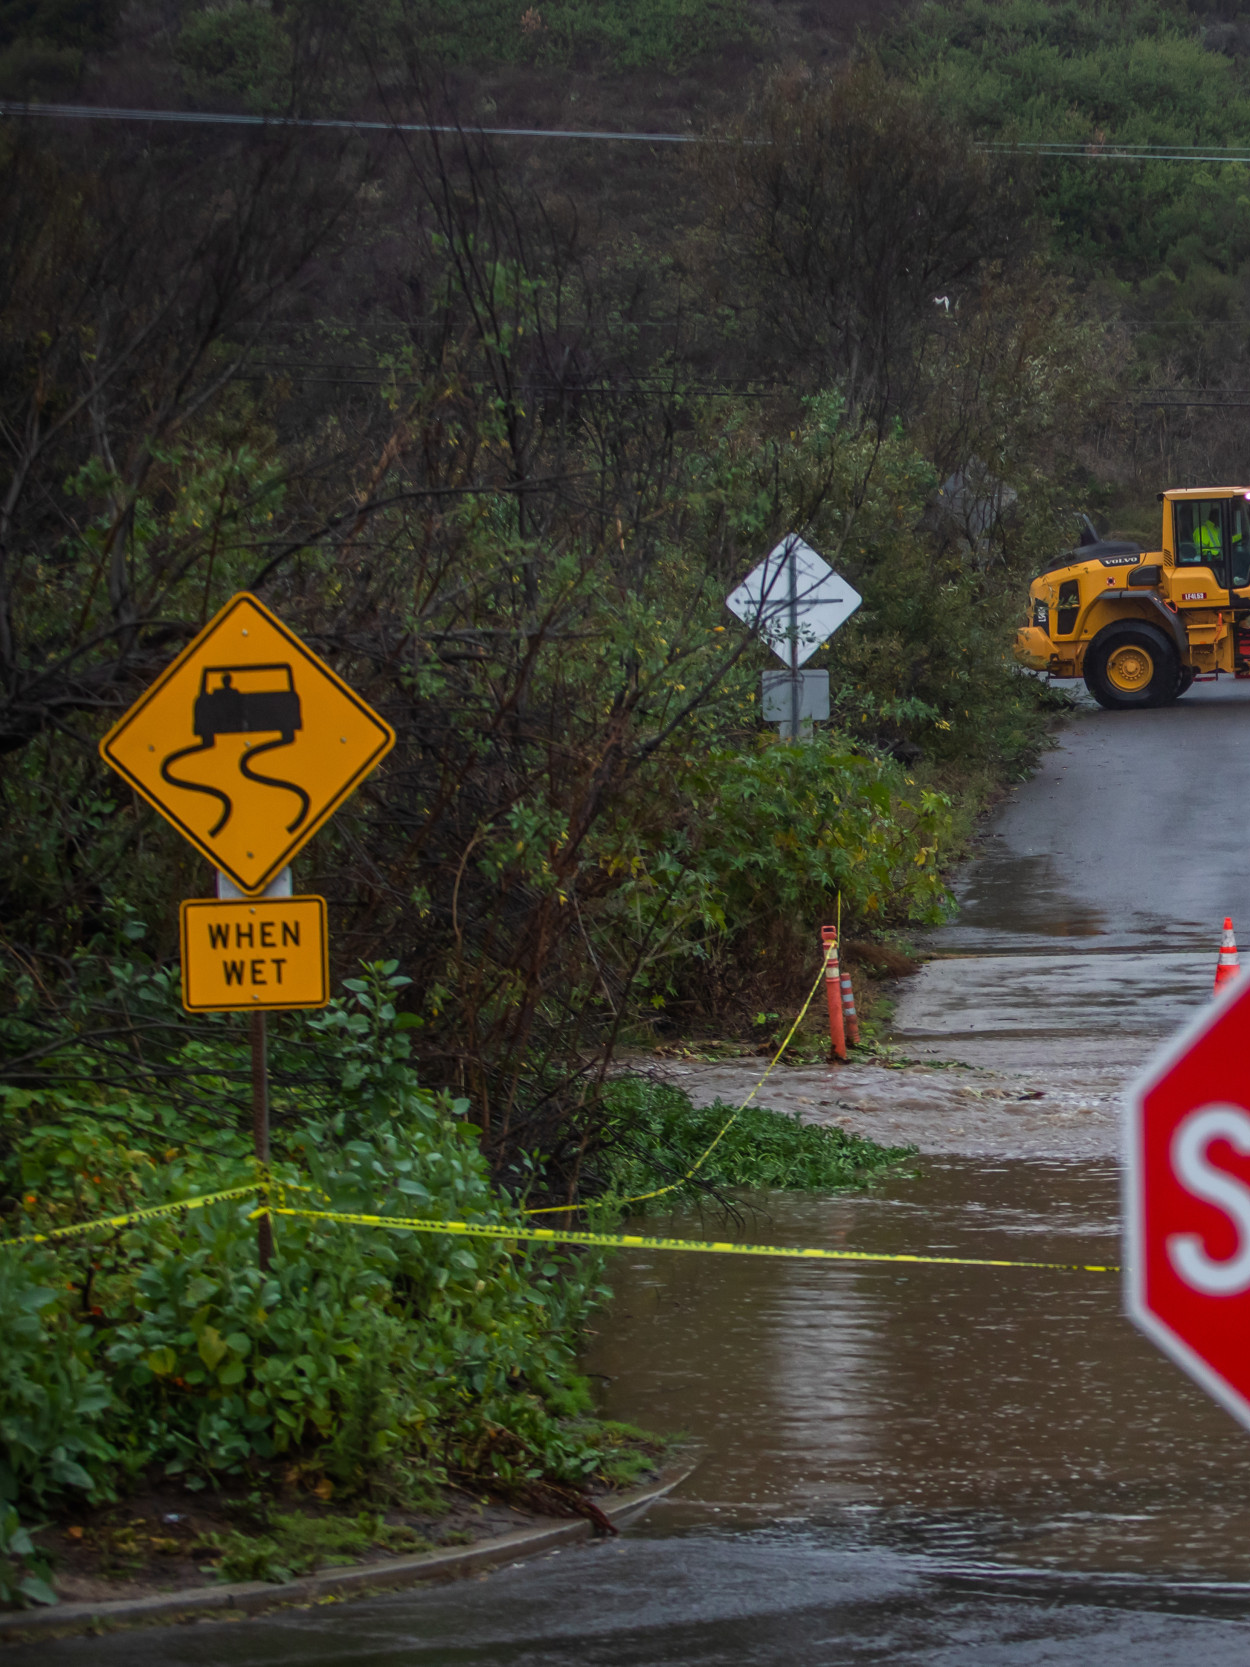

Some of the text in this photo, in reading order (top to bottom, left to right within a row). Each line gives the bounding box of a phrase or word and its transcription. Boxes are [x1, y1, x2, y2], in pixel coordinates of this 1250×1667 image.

[1104, 557, 1138, 565] VOLVO
[208, 920, 300, 950] WHEN
[222, 958, 288, 986] WET
